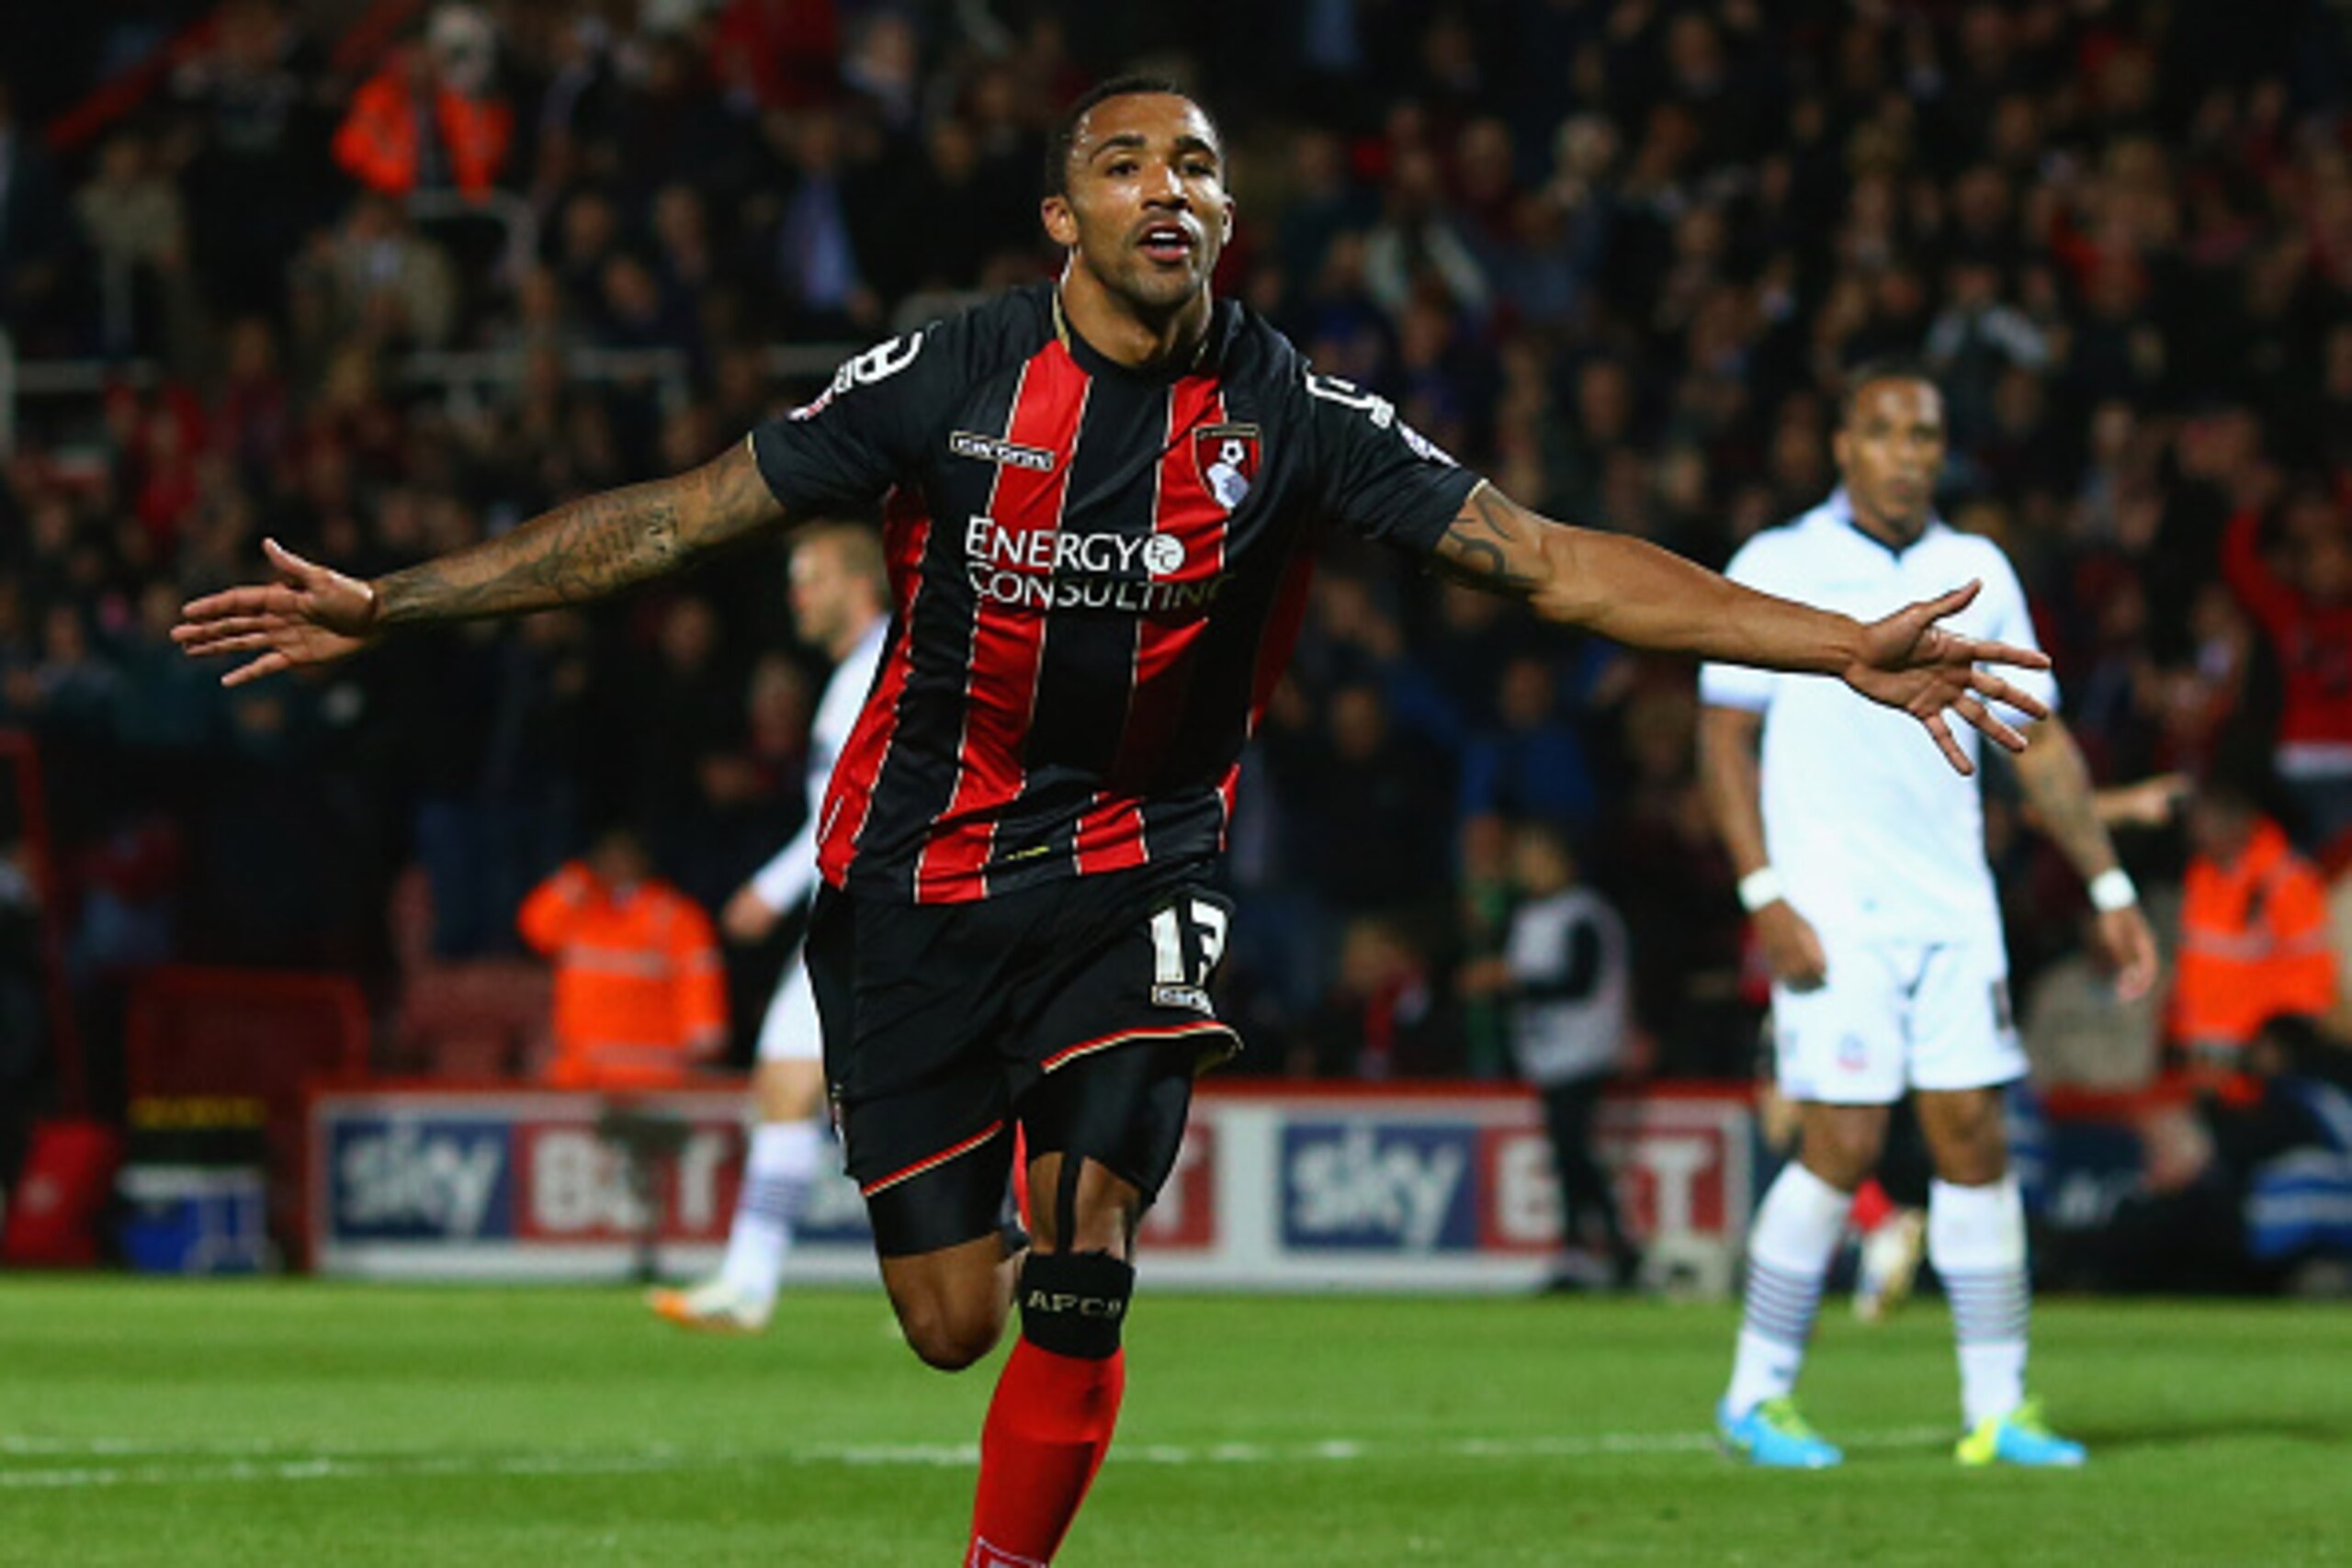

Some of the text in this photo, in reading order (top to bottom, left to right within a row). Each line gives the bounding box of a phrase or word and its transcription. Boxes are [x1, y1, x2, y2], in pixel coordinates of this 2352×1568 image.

[965, 514, 1143, 572] ENERGY
[341, 1115, 503, 1237] sky
[1291, 1127, 1465, 1249] sky
[1498, 1137, 1713, 1240] BT
